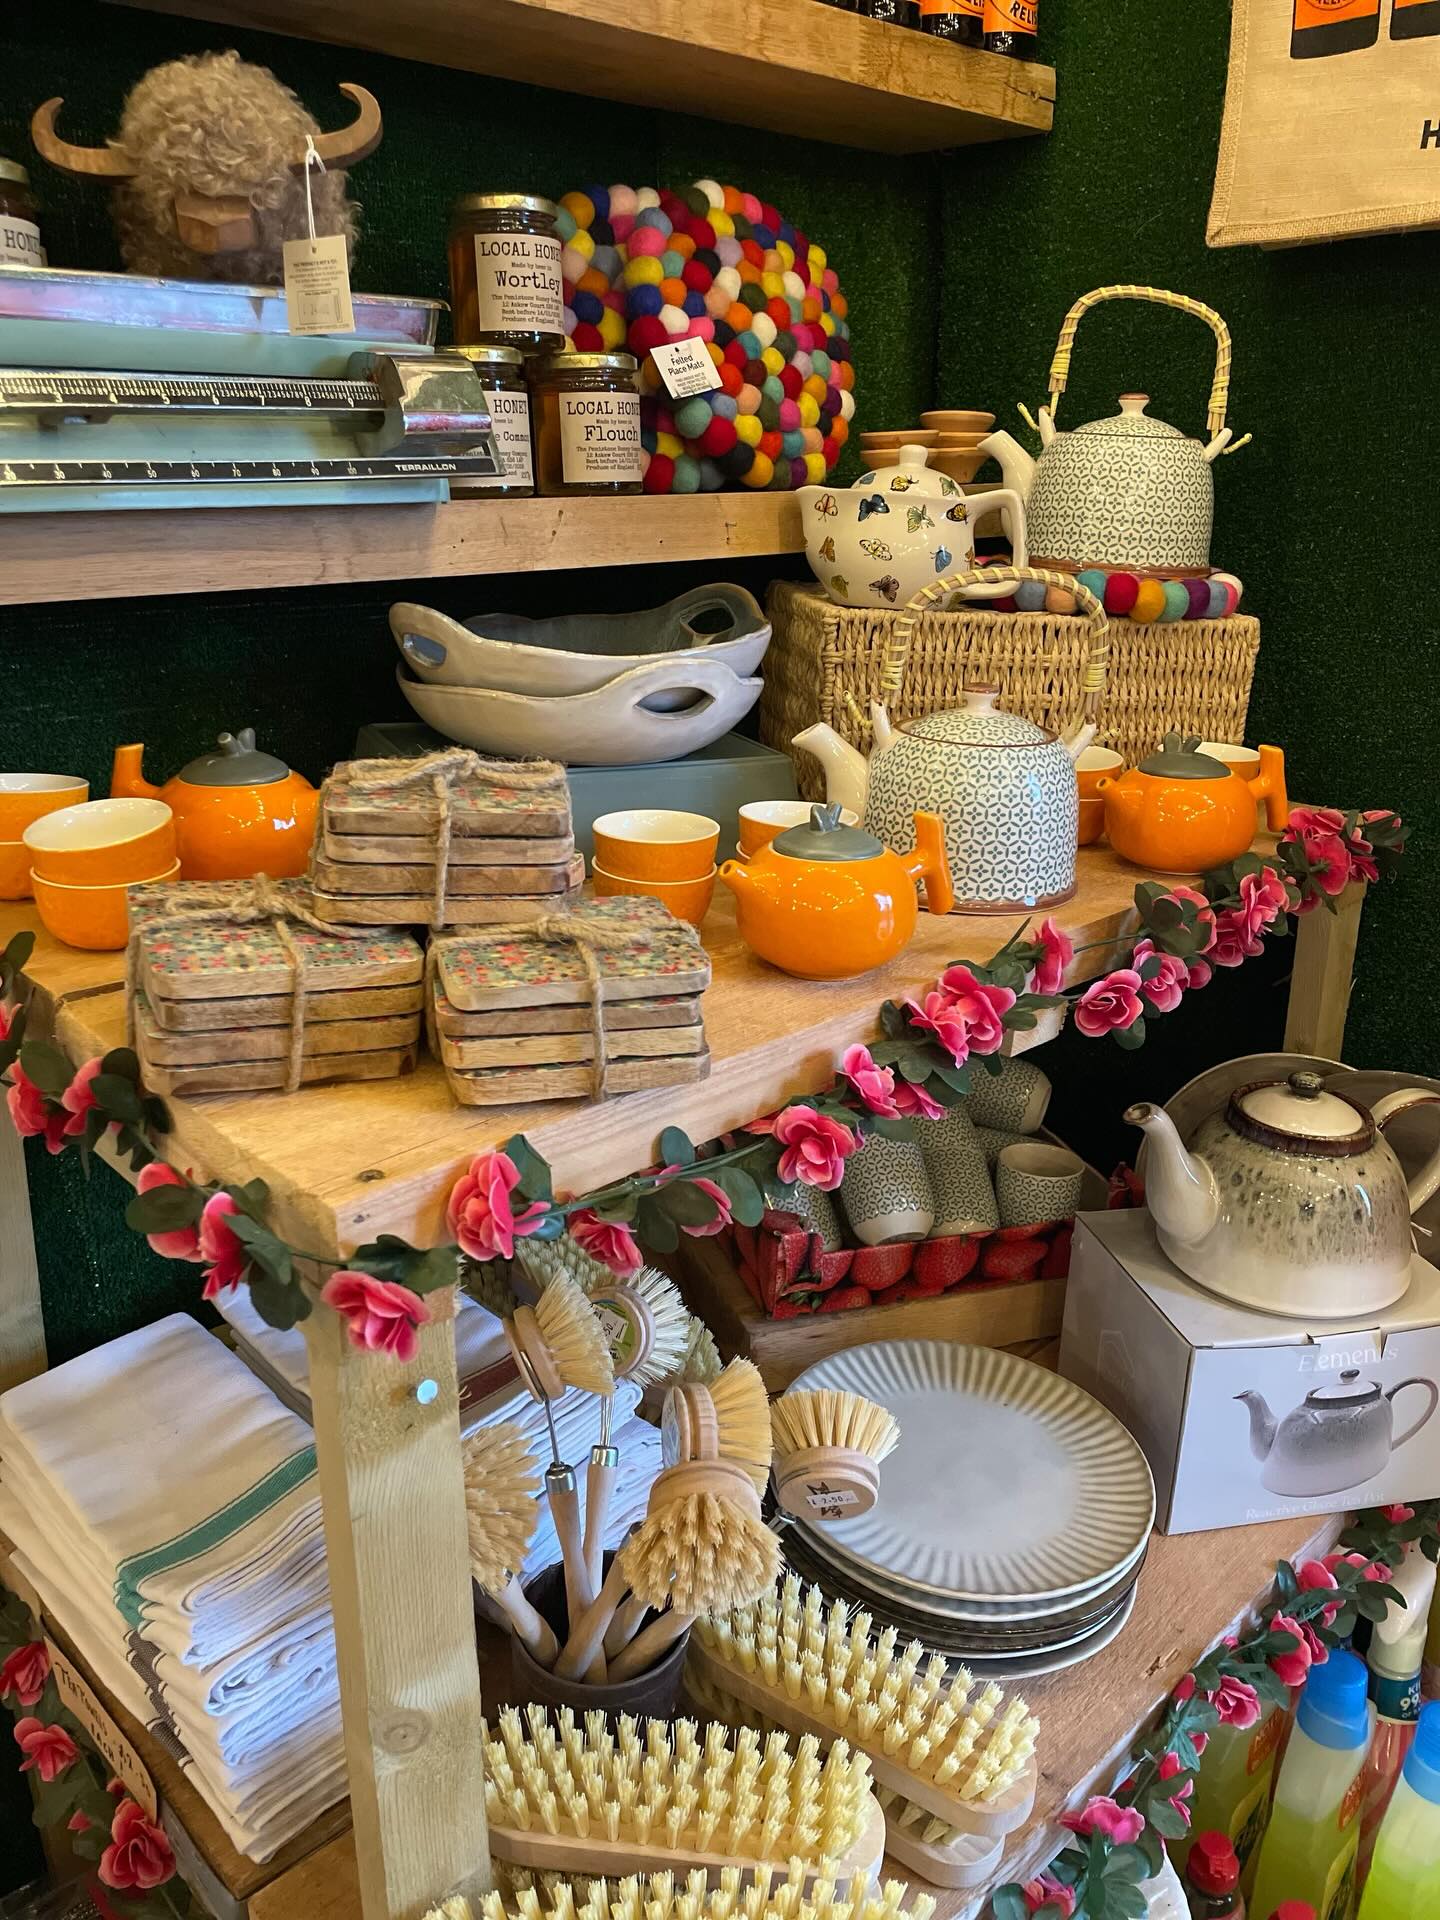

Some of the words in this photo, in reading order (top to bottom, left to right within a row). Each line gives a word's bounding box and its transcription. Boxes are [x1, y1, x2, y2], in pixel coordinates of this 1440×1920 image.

[480, 241, 530, 257] LOCAL
[527, 262, 534, 270] by
[494, 270, 560, 296] Wortley
[670, 355, 694, 366] Felted
[668, 366, 687, 377] Place
[687, 360, 705, 371] Mats
[567, 401, 613, 415] LOCAL
[584, 425, 639, 442] Flouch
[394, 463, 457, 471] TERRAILLON
